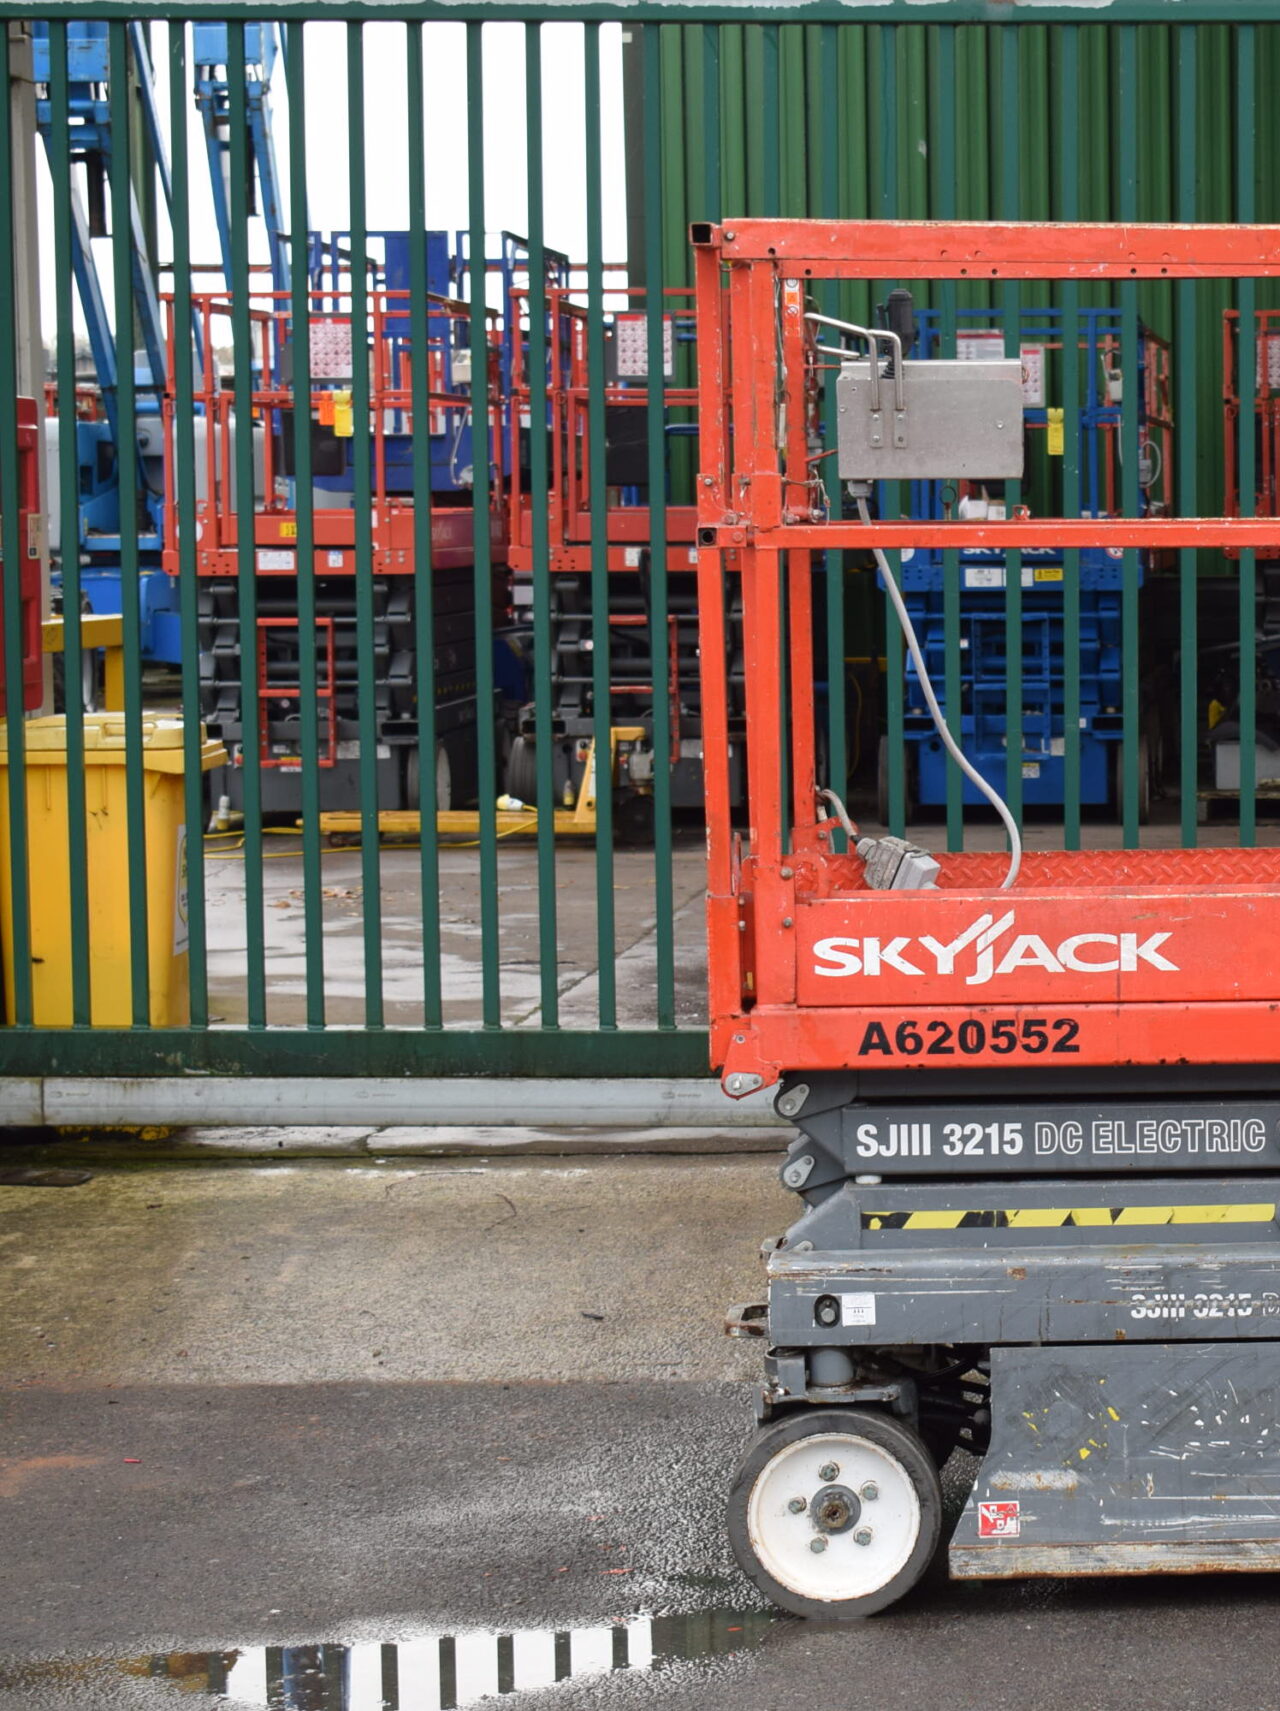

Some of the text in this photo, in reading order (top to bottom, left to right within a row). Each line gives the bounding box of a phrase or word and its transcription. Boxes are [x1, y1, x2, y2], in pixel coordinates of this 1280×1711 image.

[812, 909, 1180, 985] SKYJACK
[858, 1019, 1081, 1056] A620552
[856, 1118, 1266, 1157] SJIII 3215 DC ELECTRIC
